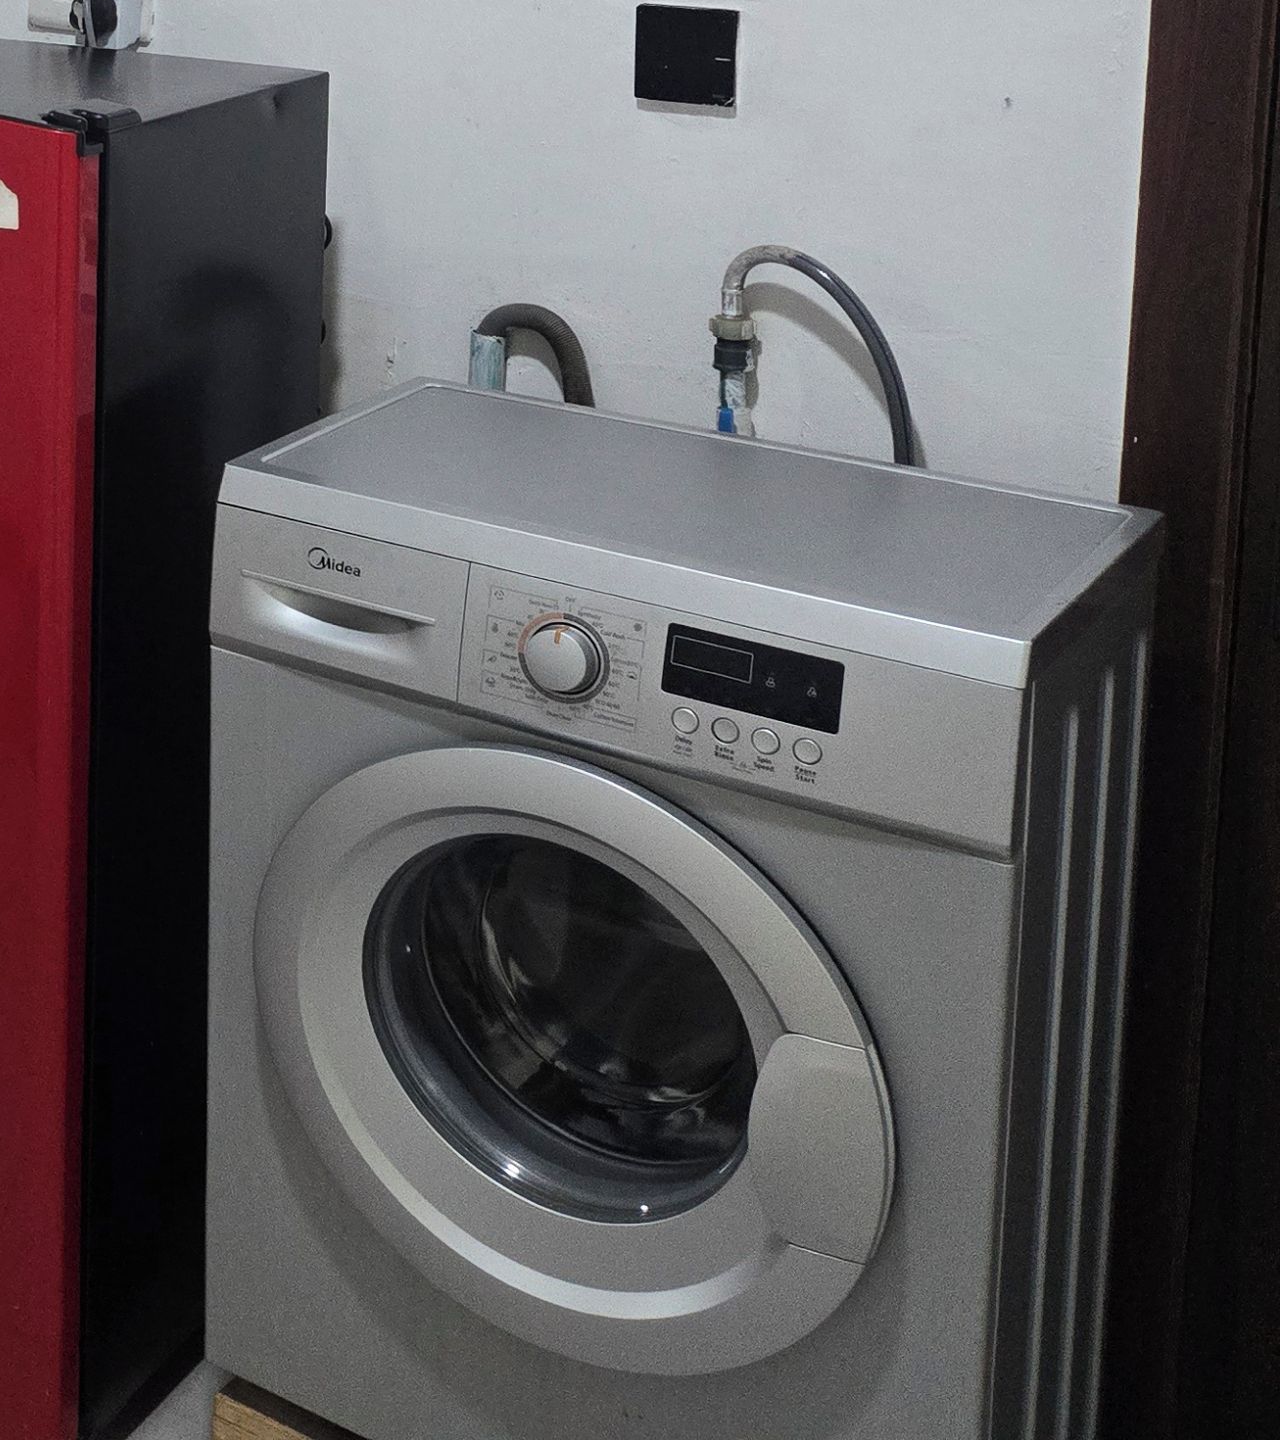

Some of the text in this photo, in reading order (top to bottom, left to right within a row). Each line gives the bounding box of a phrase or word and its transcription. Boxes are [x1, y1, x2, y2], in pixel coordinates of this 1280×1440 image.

[307, 547, 361, 577] Midea
[753, 761, 776, 773] Speed
[794, 765, 817, 777] Pause
[794, 773, 816, 785] Start
